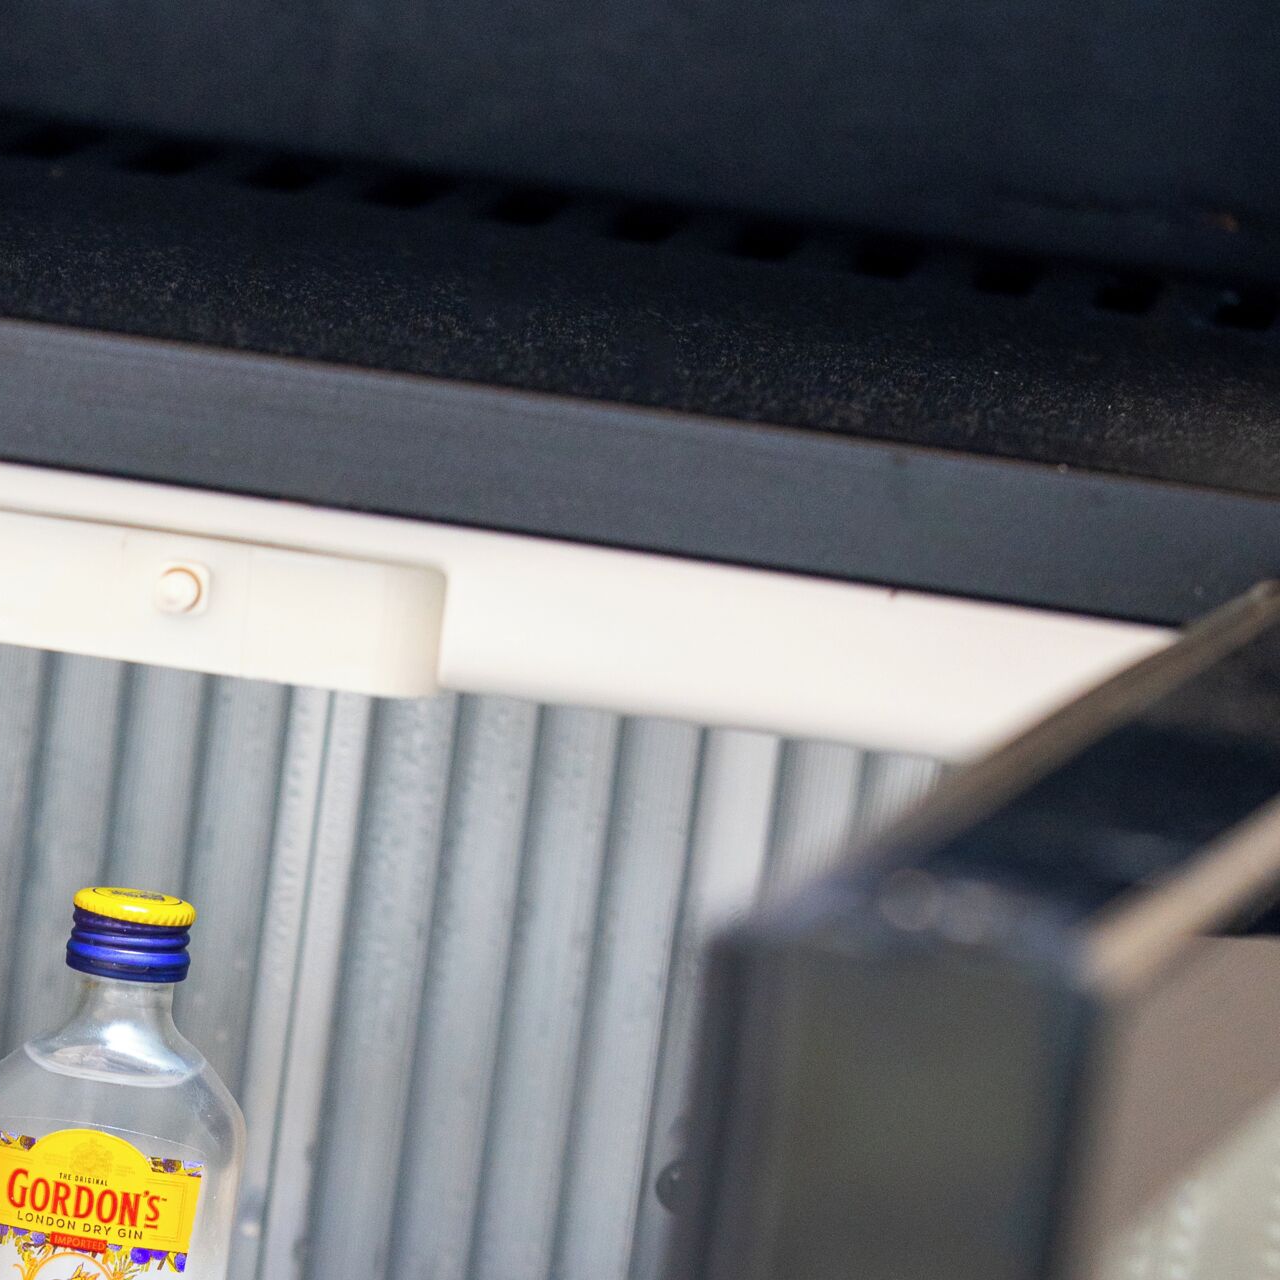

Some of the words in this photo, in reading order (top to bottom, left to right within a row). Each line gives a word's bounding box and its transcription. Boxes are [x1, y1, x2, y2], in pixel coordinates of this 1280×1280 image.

[59, 1172, 72, 1181] THE
[74, 1175, 108, 1186] ORIGINAL
[7, 1168, 160, 1230] GORDON'S
[17, 1211, 76, 1231] LONDON
[82, 1224, 112, 1237] DRY
[118, 1228, 143, 1240] GIN
[54, 1234, 107, 1251] IMPORTED
